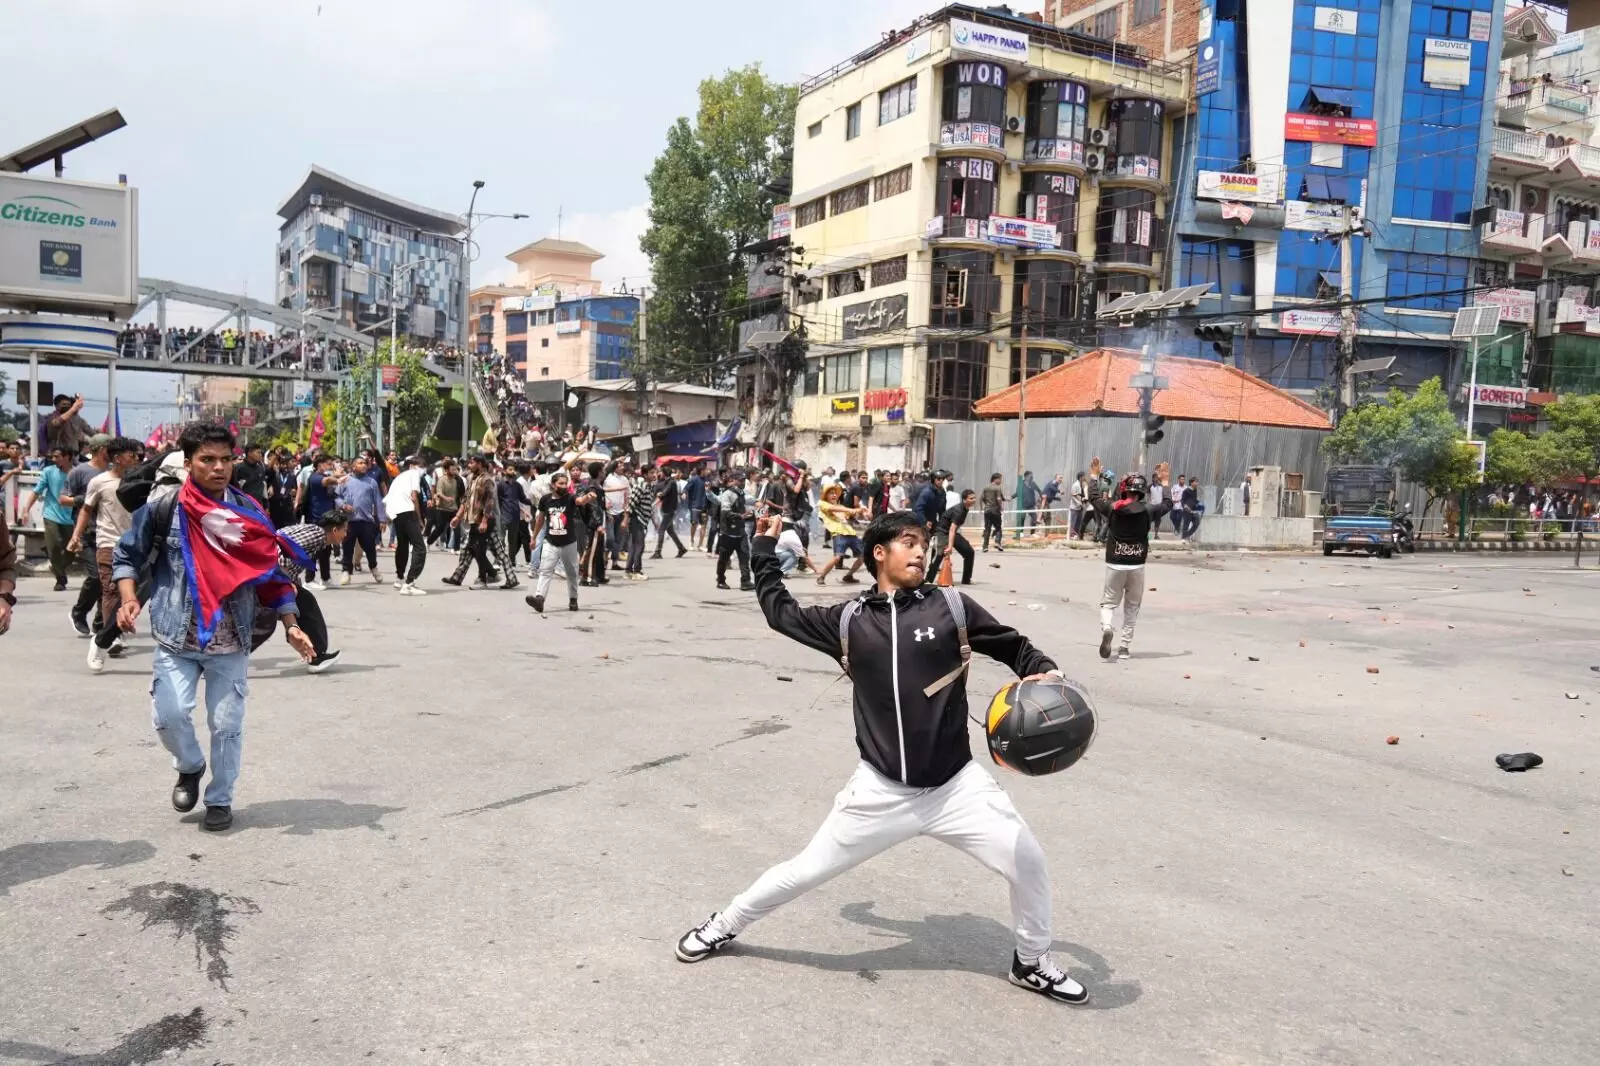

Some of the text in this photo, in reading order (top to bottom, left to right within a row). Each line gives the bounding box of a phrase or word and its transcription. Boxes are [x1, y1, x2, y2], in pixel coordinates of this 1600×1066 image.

[971, 31, 999, 45] HAPPY
[999, 37, 1027, 51] PANDA
[1434, 41, 1468, 50] EDUVICE
[955, 132, 970, 141] USA
[972, 133, 987, 144] PTE
[990, 135, 1000, 146] UK
[1219, 174, 1258, 186] PASSION
[1, 203, 118, 228] Citizens Bank
[1480, 388, 1524, 404] GORETO
